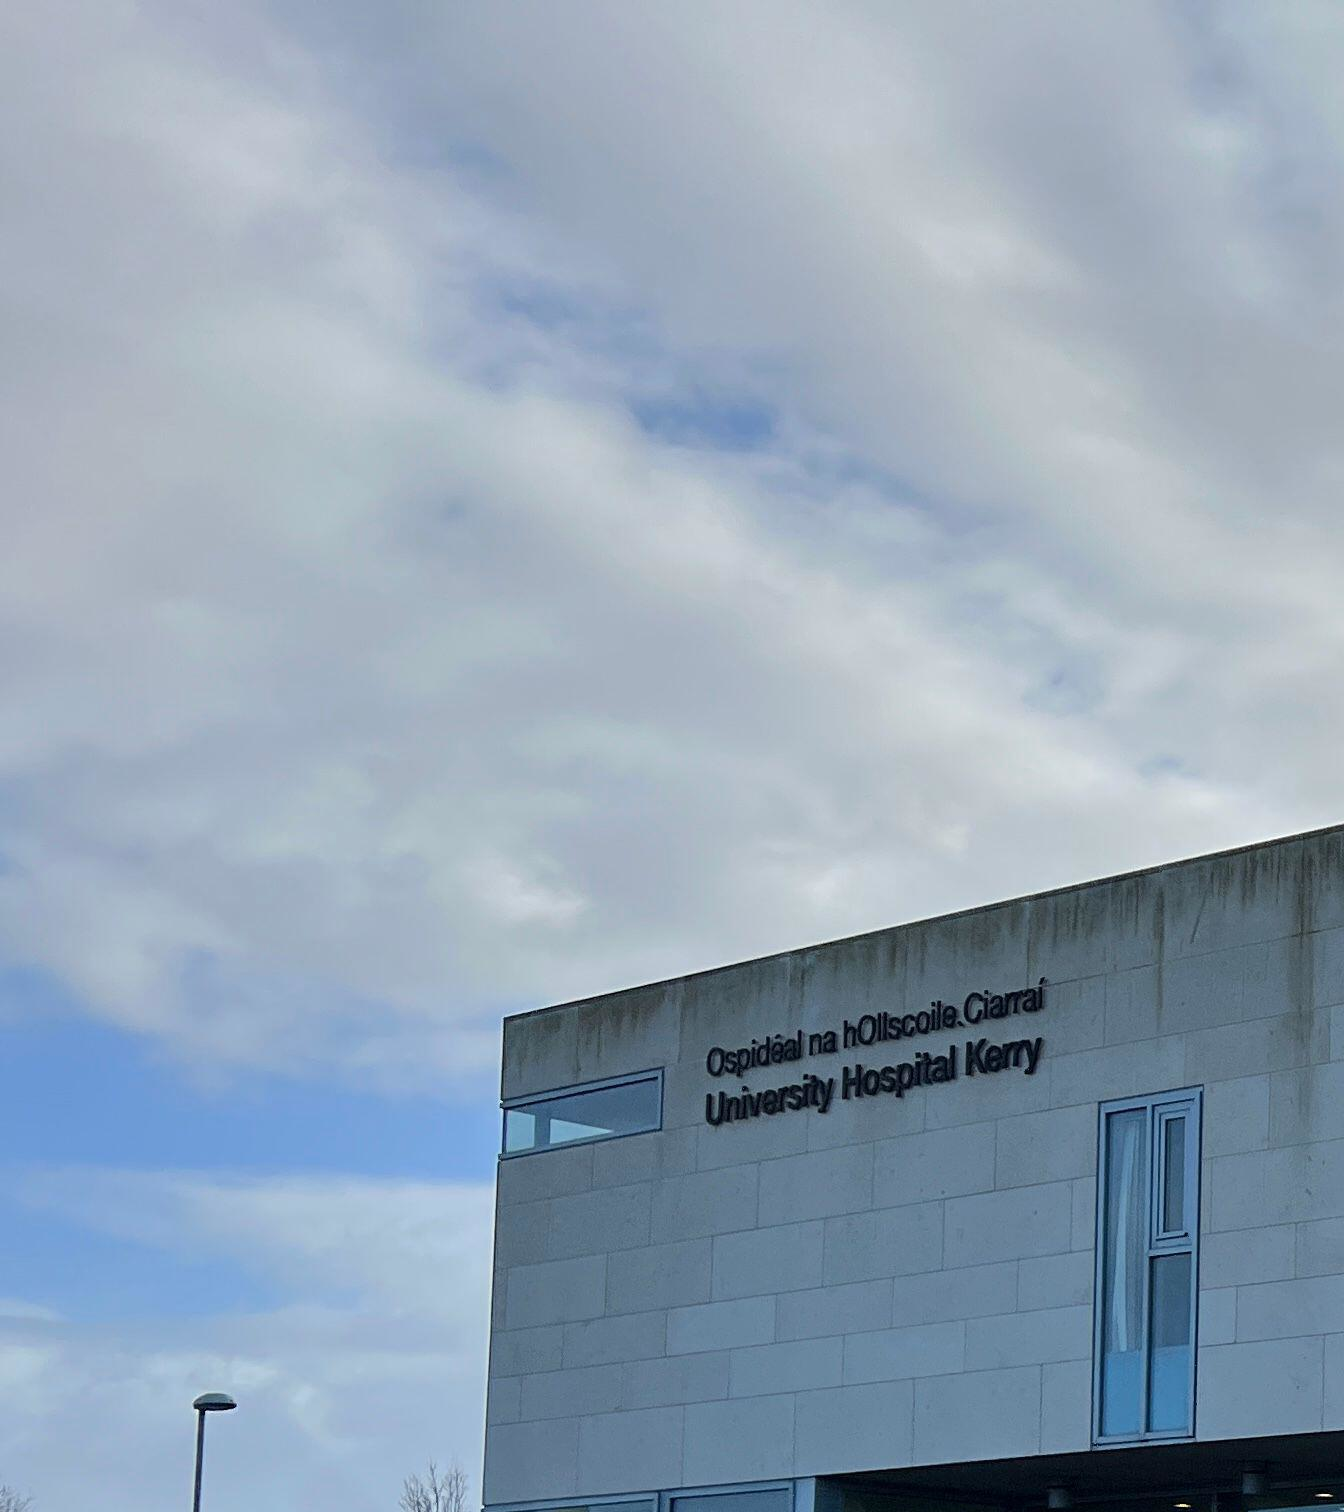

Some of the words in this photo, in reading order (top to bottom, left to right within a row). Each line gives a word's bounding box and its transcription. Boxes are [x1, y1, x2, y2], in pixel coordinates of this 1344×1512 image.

[808, 1030, 838, 1056] na
[963, 976, 1048, 1025] Ciarraí
[705, 1073, 836, 1126] University
[841, 1044, 957, 1099] Hospital
[965, 1037, 1043, 1075] Kerry
